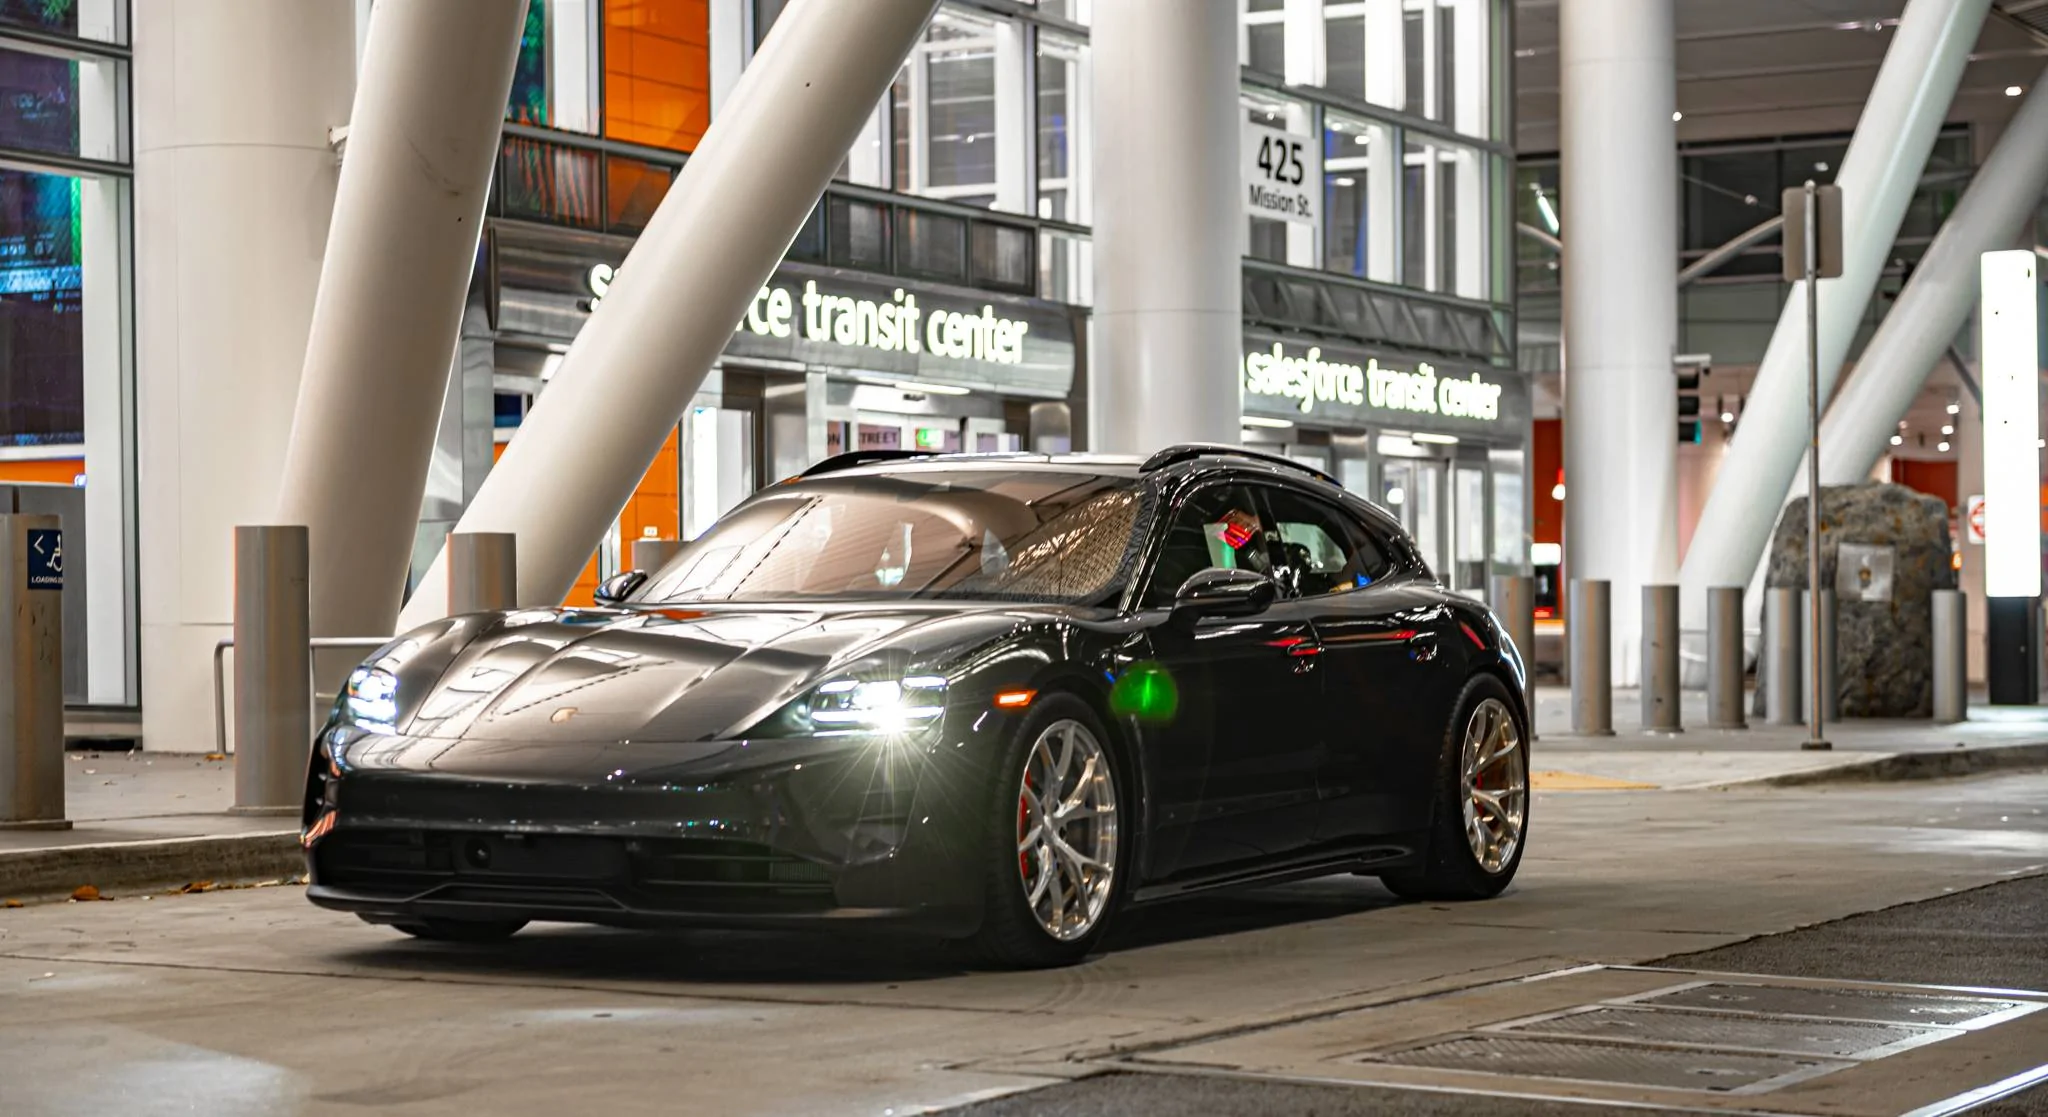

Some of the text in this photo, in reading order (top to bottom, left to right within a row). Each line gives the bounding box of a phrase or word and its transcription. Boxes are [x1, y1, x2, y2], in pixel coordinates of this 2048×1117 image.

[1257, 136, 1303, 185] 425
[1249, 184, 1312, 217] Mission St.
[802, 280, 920, 354] transit
[927, 305, 1028, 363] center
[1247, 342, 1501, 420] salesforce transit center
[860, 432, 897, 443] TREET
